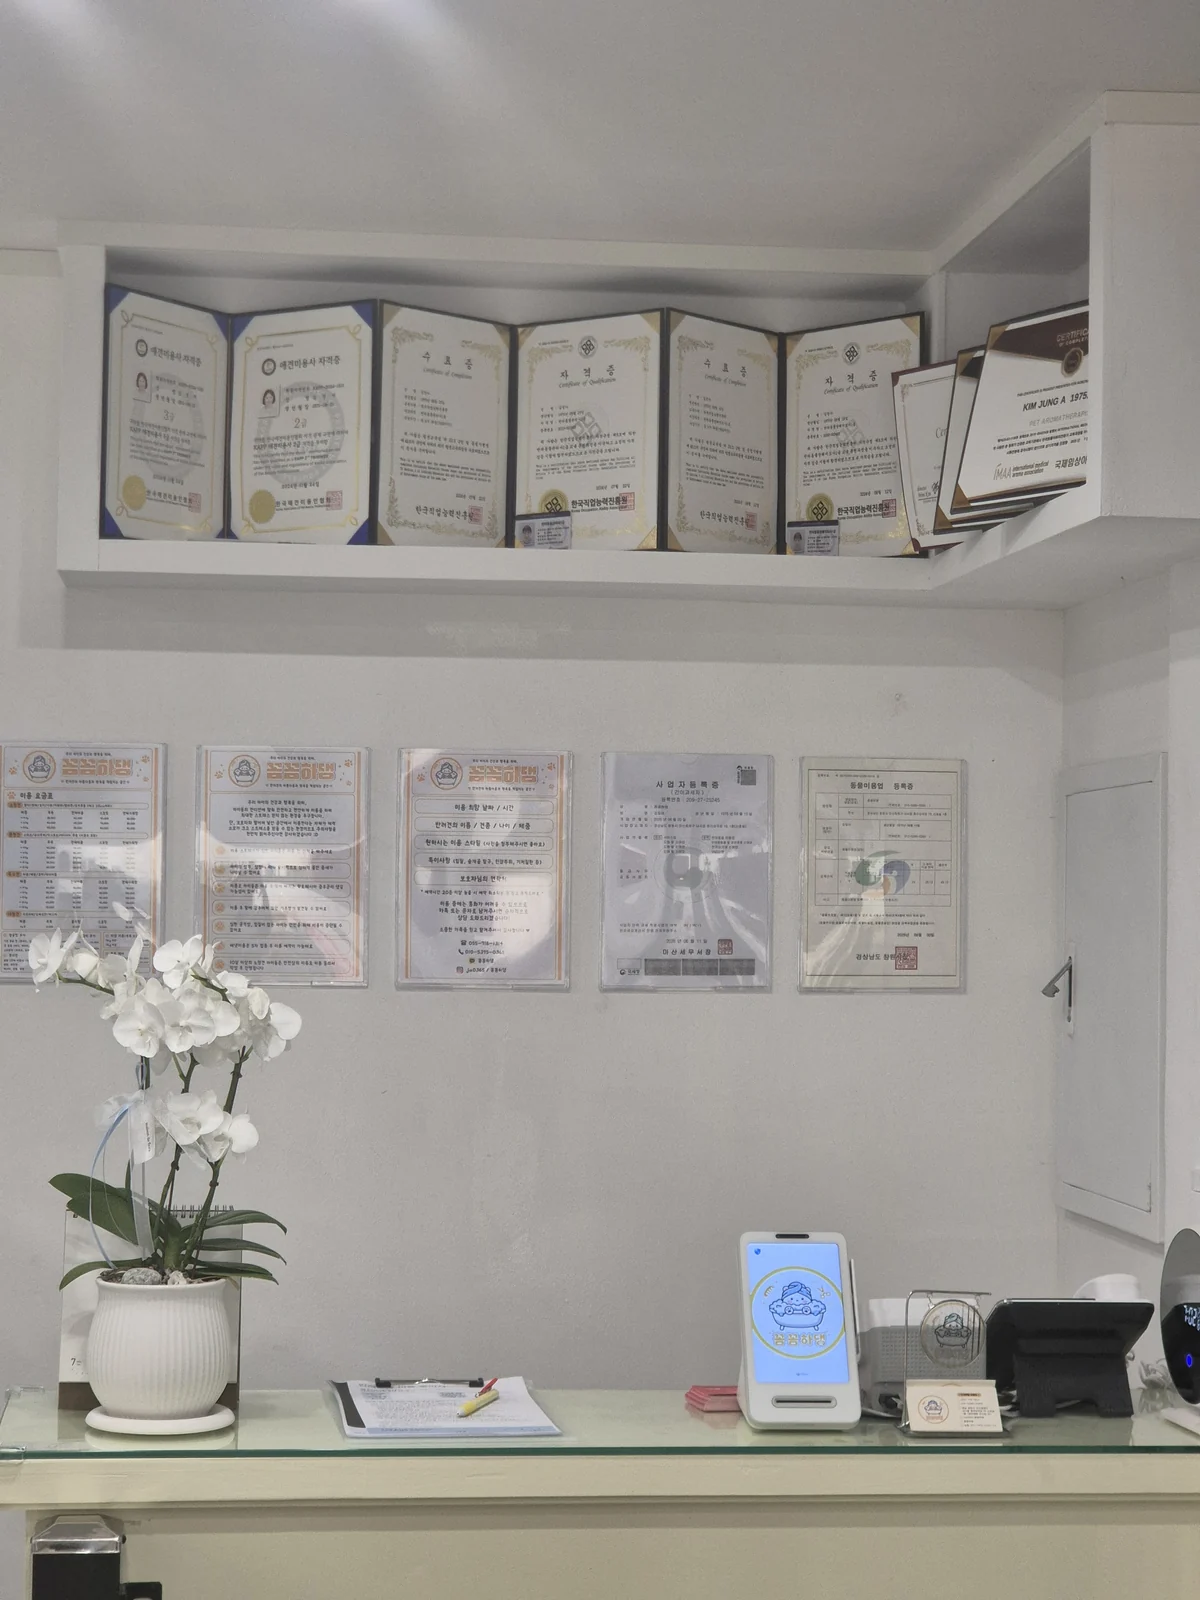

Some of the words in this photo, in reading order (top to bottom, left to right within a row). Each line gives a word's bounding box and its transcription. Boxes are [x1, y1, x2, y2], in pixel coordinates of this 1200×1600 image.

[280, 358, 316, 370] 애견미용사
[318, 355, 340, 366] 자격증
[589, 377, 616, 386] Qualification
[852, 383, 878, 392] Qualification
[1022, 402, 1037, 412] KIM
[1038, 397, 1059, 409] JUNG
[1060, 396, 1066, 404] A
[1029, 419, 1040, 427] PET
[571, 496, 628, 509] 한국직업능력진흥원
[837, 503, 890, 516] 한국직업능력진흥원
[20, 792, 32, 800] 미용
[35, 792, 53, 800] 요금표
[428, 856, 451, 864] 특이사항
[460, 875, 488, 883] 보호자님의
[772, 1332, 826, 1347] 꼼꼼하댕
